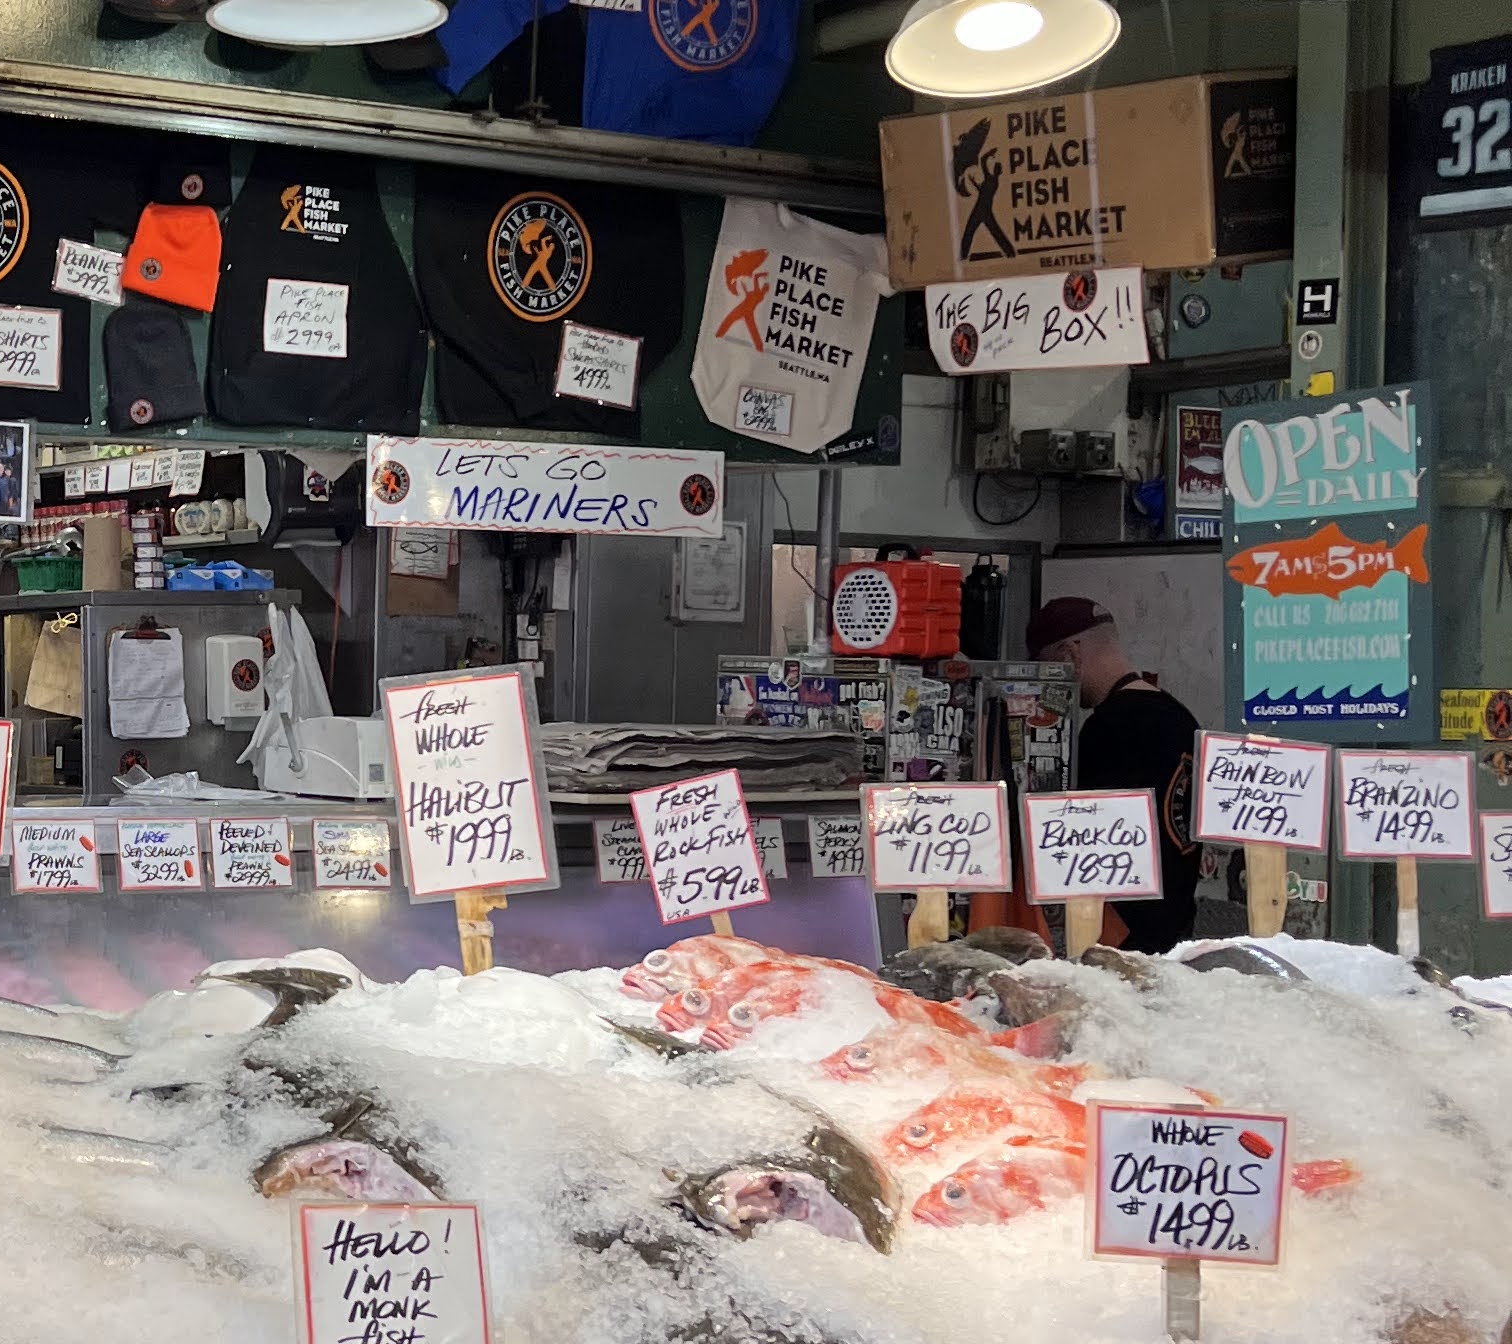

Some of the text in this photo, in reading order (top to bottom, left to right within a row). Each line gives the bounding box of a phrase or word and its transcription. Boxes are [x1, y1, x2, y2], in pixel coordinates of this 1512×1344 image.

[1450, 62, 1508, 95] KRAKEN
[1007, 105, 1067, 140] PIKE
[1437, 96, 1512, 178] 32
[1007, 137, 1098, 175] PLACE
[304, 197, 340, 212] PLACE
[305, 185, 330, 199] PIKE
[1011, 176, 1071, 209] FISH
[303, 207, 329, 222] FISH
[303, 219, 349, 235] MARKET
[501, 204, 581, 249] PIKE PLACE
[1013, 205, 1128, 242] MARKET
[62, 245, 124, 278] BEANIES
[778, 255, 828, 287] PIKE
[280, 284, 346, 300] PIKE PLACE
[499, 262, 580, 309] FISH MARKET
[774, 279, 845, 318] PLACE
[273, 311, 336, 326] APRON
[293, 298, 323, 311] FISH
[769, 303, 818, 334] FISH
[934, 286, 1031, 334] THE BIG
[764, 326, 854, 369] MARKET
[435, 447, 607, 481] LETS GO
[1223, 388, 1412, 509] OPEN
[1307, 466, 1428, 507] DAILY
[444, 482, 659, 531] MARINERS
[1253, 604, 1288, 628] CALL
[398, 688, 474, 724] FRESH
[1252, 701, 1400, 717] CLOSED MOST HOLIDAYS
[414, 721, 495, 755] WHOLE
[1206, 755, 1316, 790] RAINBOW
[405, 776, 530, 828] HALIBUT
[654, 783, 719, 814] FRESH
[1212, 783, 1303, 803] TROUT
[1344, 775, 1461, 811] BRANZINO
[19, 824, 77, 843] MEDIUM
[133, 828, 172, 845] LARGE
[217, 819, 266, 842] PEELED
[653, 802, 722, 838] WHOLE
[813, 819, 863, 838] SALMON
[874, 807, 992, 838] LING COD
[1038, 817, 1148, 851] BLACK COD
[121, 843, 197, 859] SEA SCALLOPS
[220, 838, 283, 856] DEVEINED
[815, 836, 861, 849] JERKY
[27, 852, 85, 871] PRAWNS
[228, 860, 273, 873] PRAWNS
[665, 907, 692, 921] USA
[1151, 1115, 1235, 1148] WHOLE
[1110, 1151, 1264, 1197] OCTOPUS
[342, 1262, 445, 1301] I'M A
[347, 1295, 439, 1324] MONK
